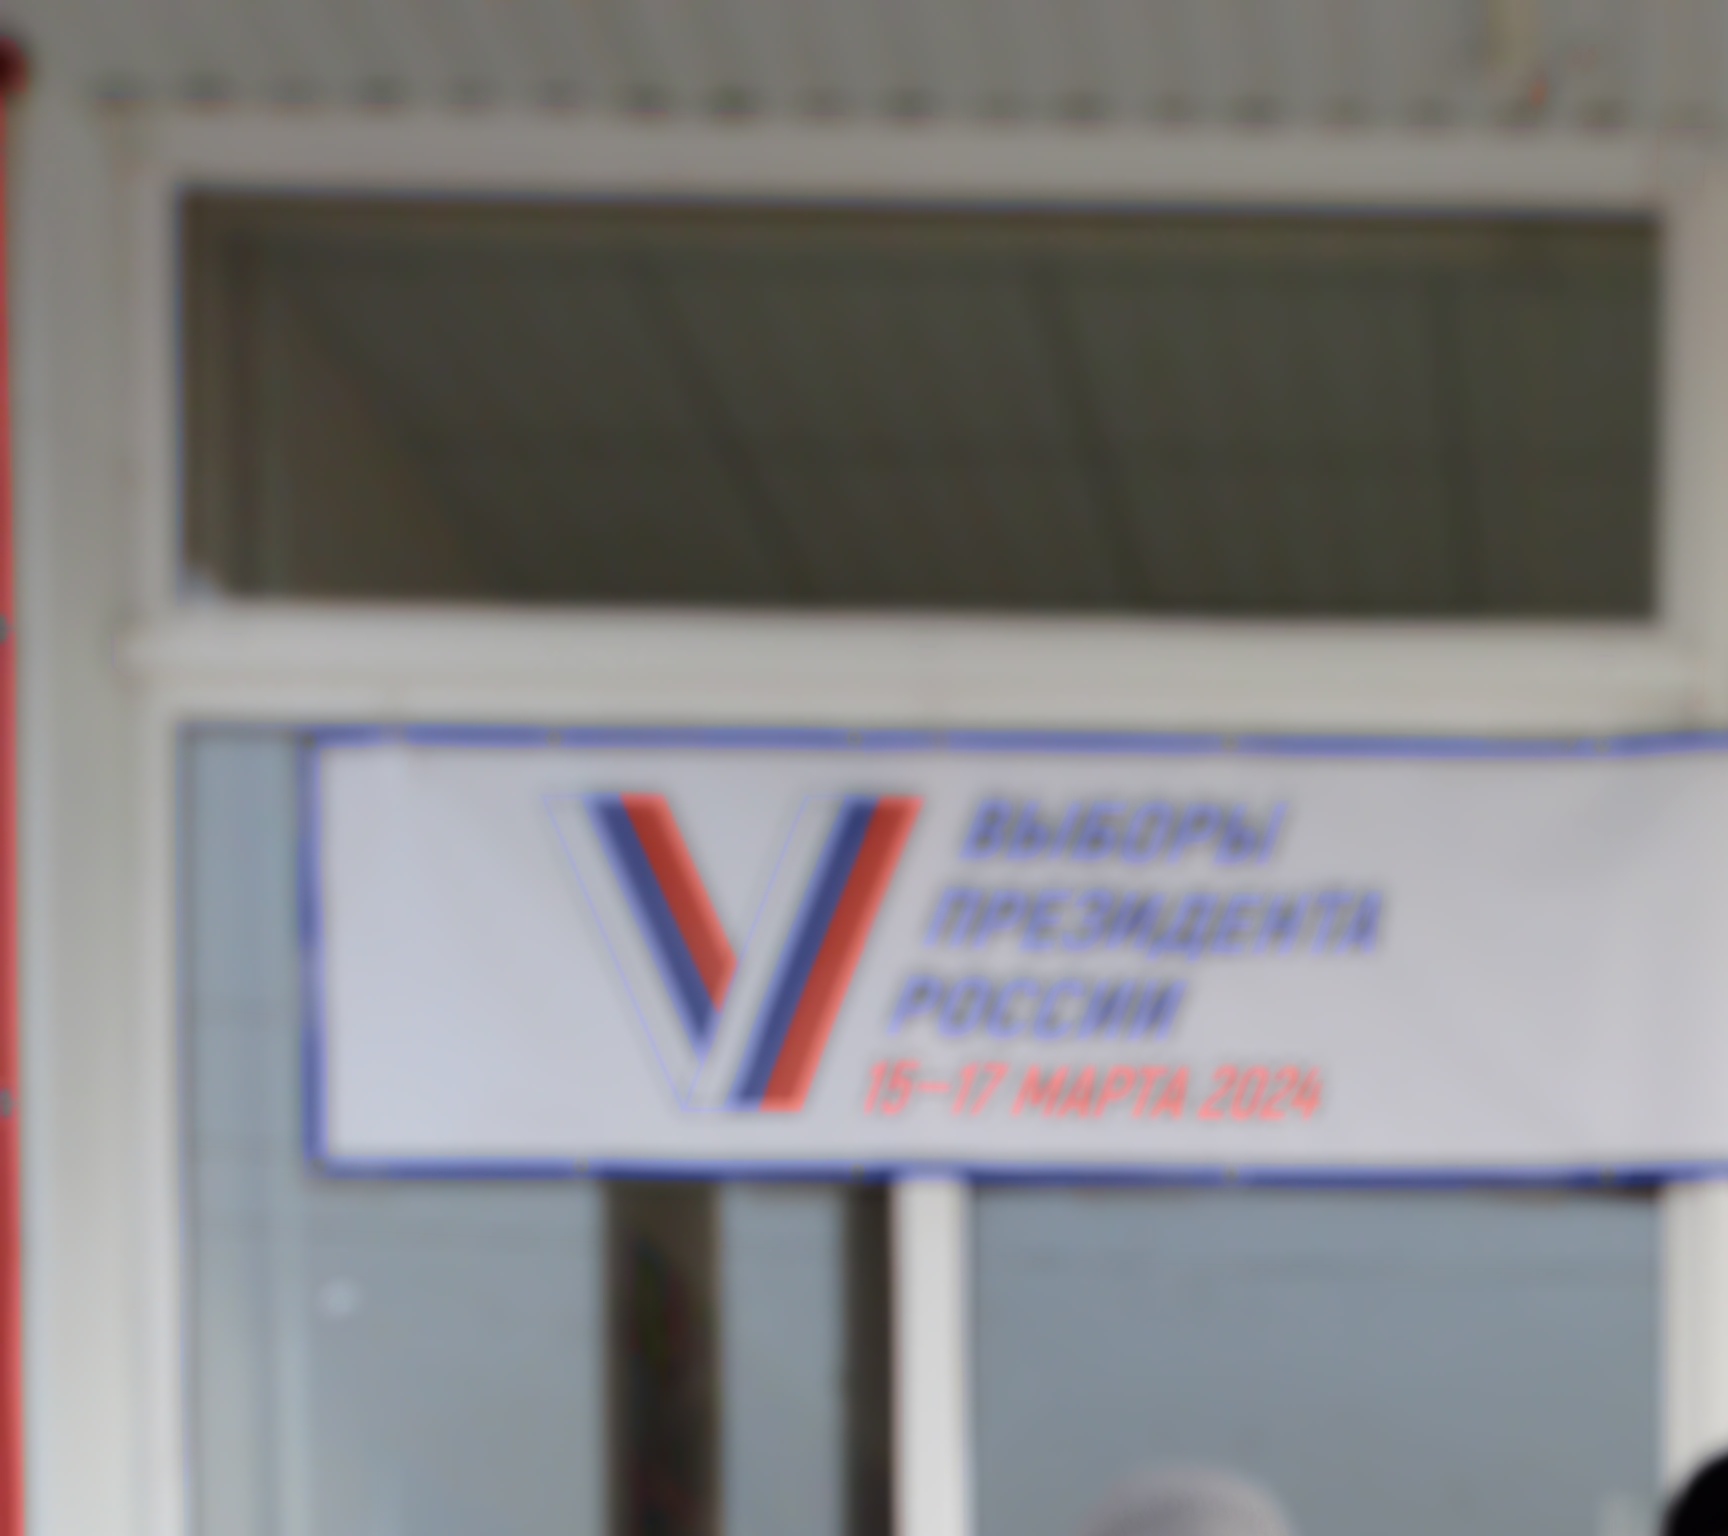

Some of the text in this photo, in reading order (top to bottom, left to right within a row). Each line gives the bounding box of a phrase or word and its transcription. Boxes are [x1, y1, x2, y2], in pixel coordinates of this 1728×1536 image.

[960, 797, 1286, 866] ВЫБОРЫ
[922, 886, 1382, 960] ПРЕЗИДЕНТА
[886, 974, 1186, 1042] РОССИИ
[1011, 1063, 1188, 1119] МАРТА
[1197, 1064, 1322, 1122] 2024
